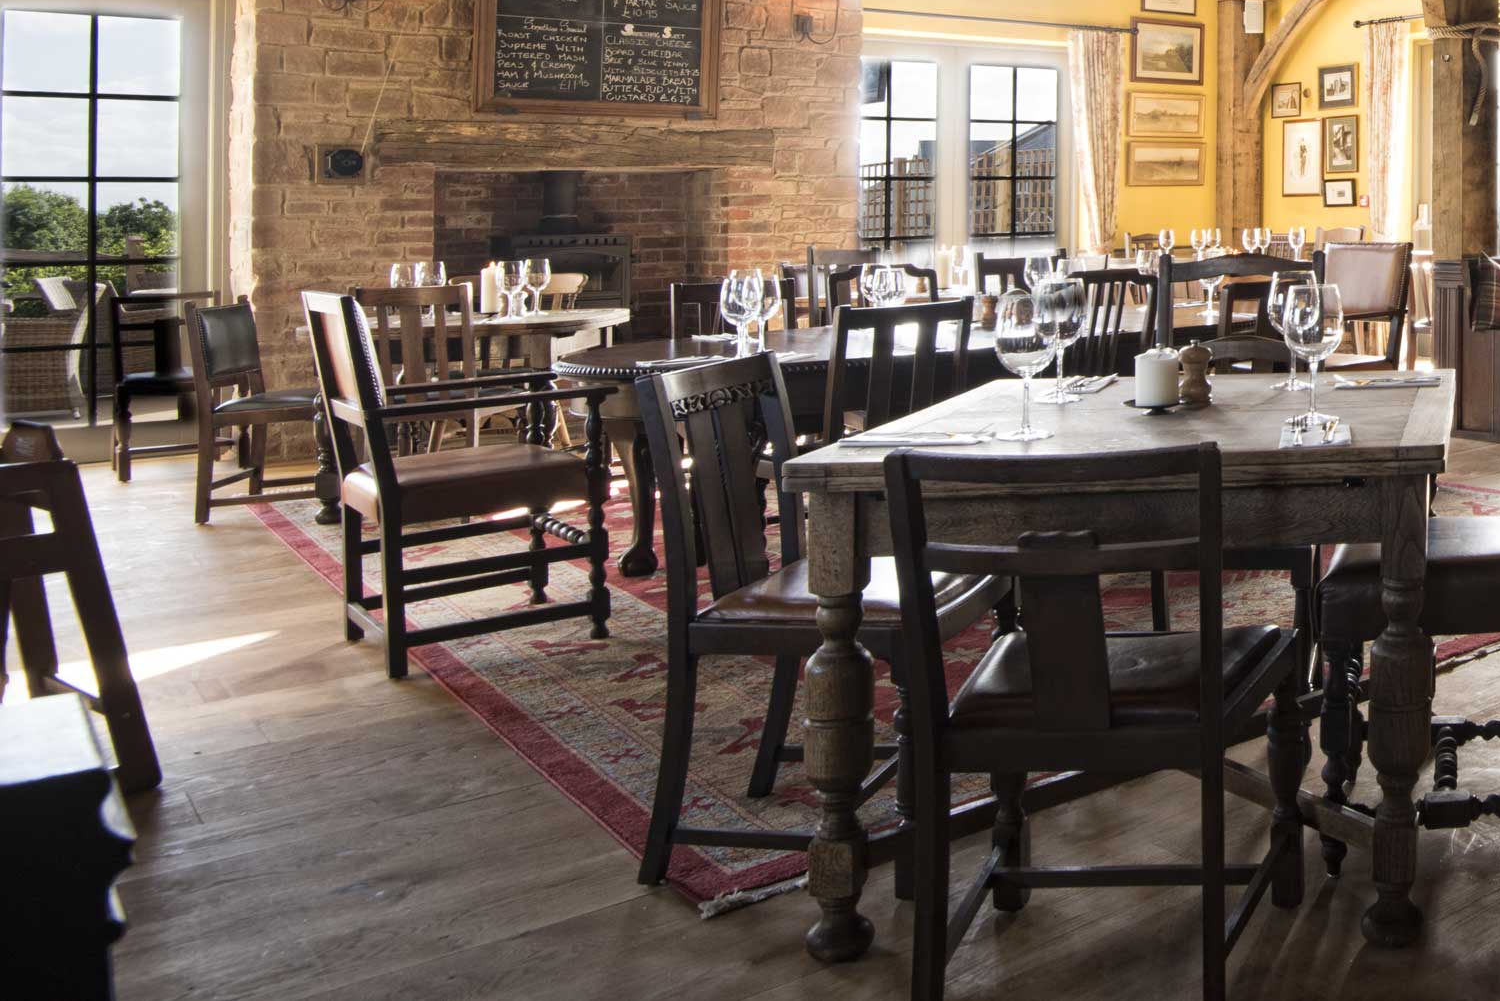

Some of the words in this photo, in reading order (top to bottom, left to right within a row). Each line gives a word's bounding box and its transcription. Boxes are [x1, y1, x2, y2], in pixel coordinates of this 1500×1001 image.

[542, 34, 587, 43] CHICKEN
[500, 40, 547, 50] SUPREME
[497, 50, 551, 60] BUTTERED
[497, 59, 524, 69] PEAS
[541, 61, 576, 72] CREAMY
[533, 70, 584, 80] MUSHROOM
[498, 80, 530, 89] SAUCE
[606, 92, 656, 102] CUSTARD
